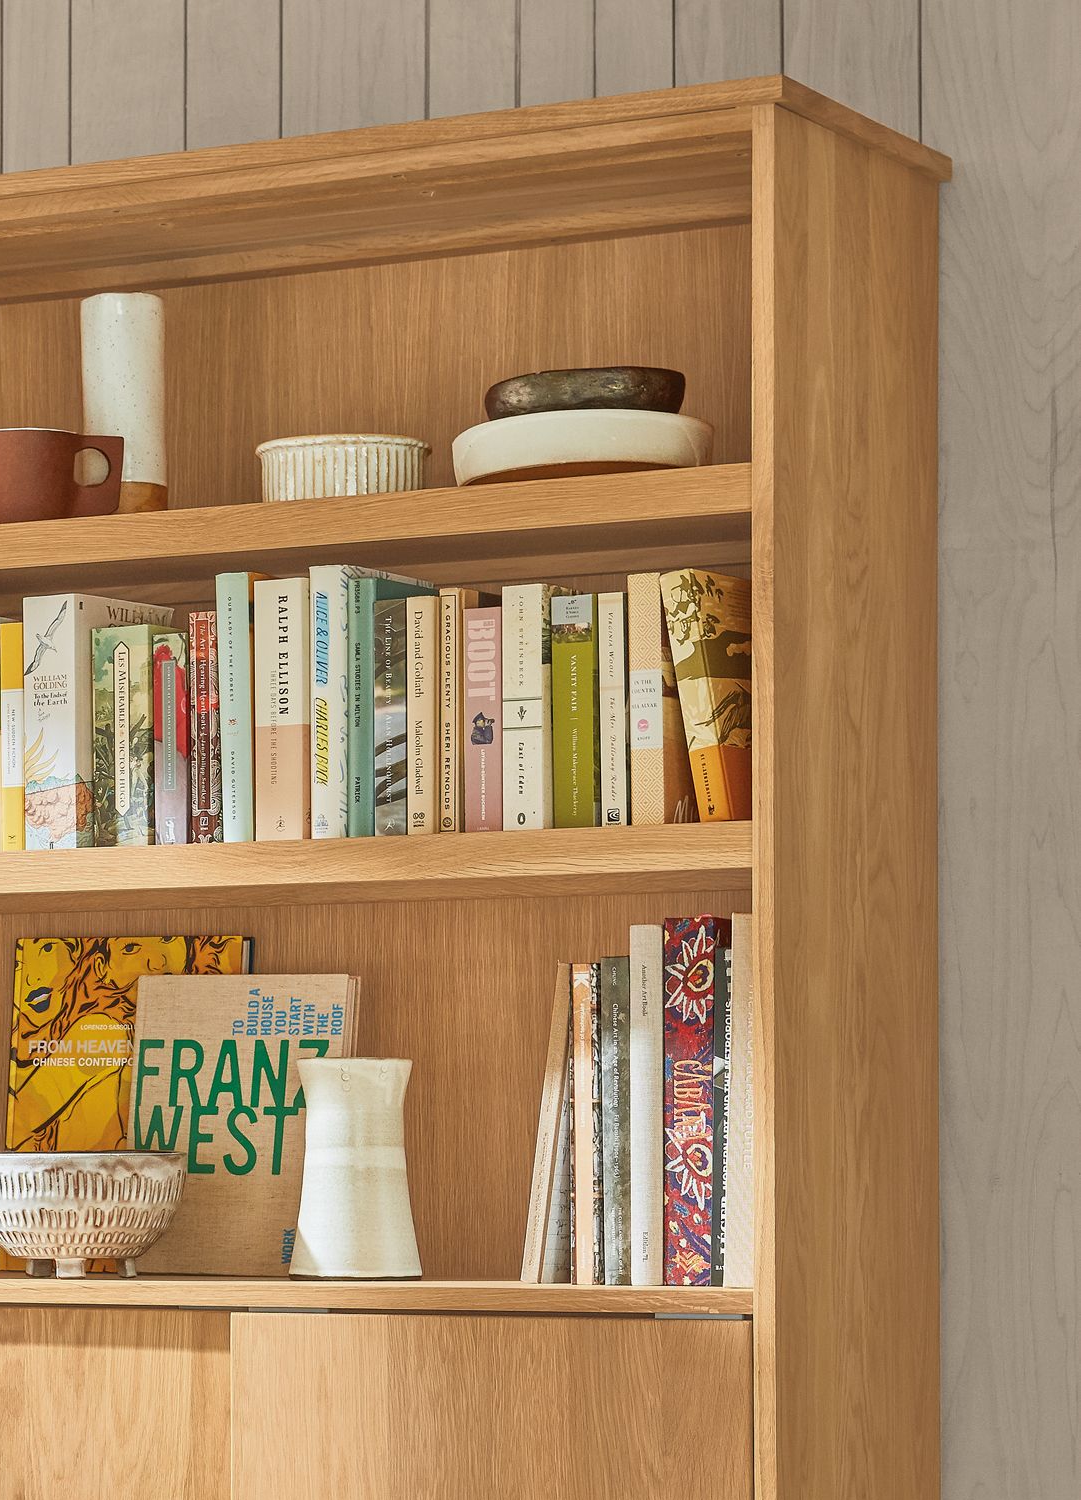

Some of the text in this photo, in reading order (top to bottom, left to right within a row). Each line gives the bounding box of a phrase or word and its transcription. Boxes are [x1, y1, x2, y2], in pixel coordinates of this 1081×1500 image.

[106, 605, 170, 626] WILLIAM
[199, 625, 207, 636] The
[199, 638, 207, 650] Art
[228, 640, 233, 650] OF
[315, 592, 329, 685] ALICE & OLIVER
[118, 651, 127, 668] LES
[278, 595, 289, 716] RALPH ELLISON
[385, 660, 392, 670] OF
[414, 611, 425, 698] David and Goliath
[467, 619, 496, 701] BOOT
[33, 674, 67, 682] WILLIAM
[33, 681, 68, 691] GOLDING
[198, 660, 207, 689] Hearing
[385, 673, 393, 705] BEAUTY
[33, 698, 68, 707] the Earth
[199, 691, 208, 730] Heartbeats
[354, 694, 361, 702] IN
[314, 697, 329, 787] CHARLES BOCK
[609, 735, 617, 772] Dalloway
[385, 715, 393, 803] ALAN HOLLINGHURST
[415, 720, 424, 795] Malcolm Gladwell
[518, 763, 525, 771] of
[571, 787, 579, 816] Thackeray
[246, 988, 261, 1036] BUILD A
[260, 995, 274, 1036] HOUSE
[275, 1010, 287, 1035] YOU
[288, 996, 302, 1036] START
[302, 1004, 316, 1036] WITH
[316, 1013, 329, 1036] THE
[330, 1003, 344, 1036] ROOF
[232, 1020, 244, 1036] TO
[28, 1039, 135, 1054] FROM HEAVEN
[613, 1046, 618, 1054] an
[32, 1058, 76, 1067] CHINESE
[613, 1067, 620, 1075] of
[744, 1063, 754, 1120] RICHARD
[614, 1114, 620, 1122] Fu
[134, 1105, 299, 1176] WEST
[743, 1123, 754, 1170] TUTTLE
[281, 1228, 296, 1264] WORK
